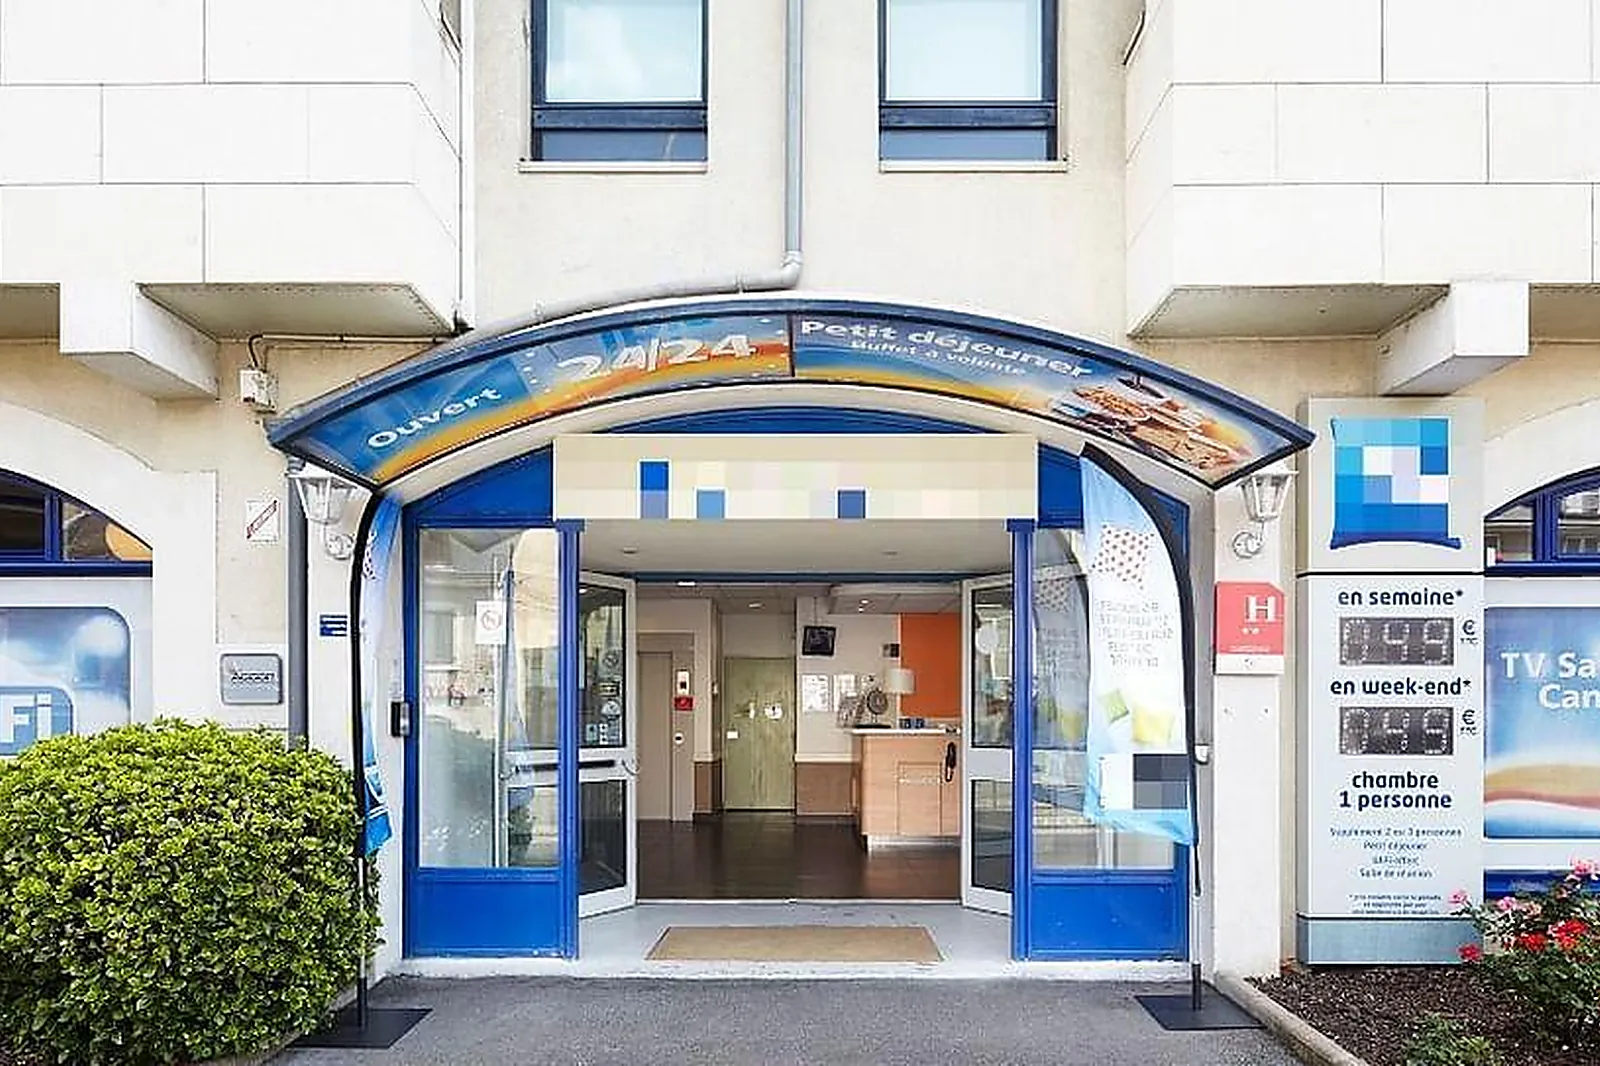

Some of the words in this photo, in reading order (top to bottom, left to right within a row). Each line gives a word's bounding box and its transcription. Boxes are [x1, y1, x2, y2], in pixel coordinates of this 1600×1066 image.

[801, 319, 898, 342] Petit
[908, 328, 1093, 378] déjeuner
[367, 386, 501, 450] Ouvert
[558, 333, 757, 380] 24/24
[1338, 591, 1362, 605] en
[1244, 594, 1276, 623] H
[1463, 619, 1476, 636] €
[1501, 652, 1547, 678] TV
[1558, 652, 1600, 679] Sa
[1331, 681, 1355, 695] en
[1462, 709, 1476, 725] €
[1352, 771, 1439, 789] chambre
[1340, 791, 1351, 807] 1
[1358, 793, 1452, 811] personne
